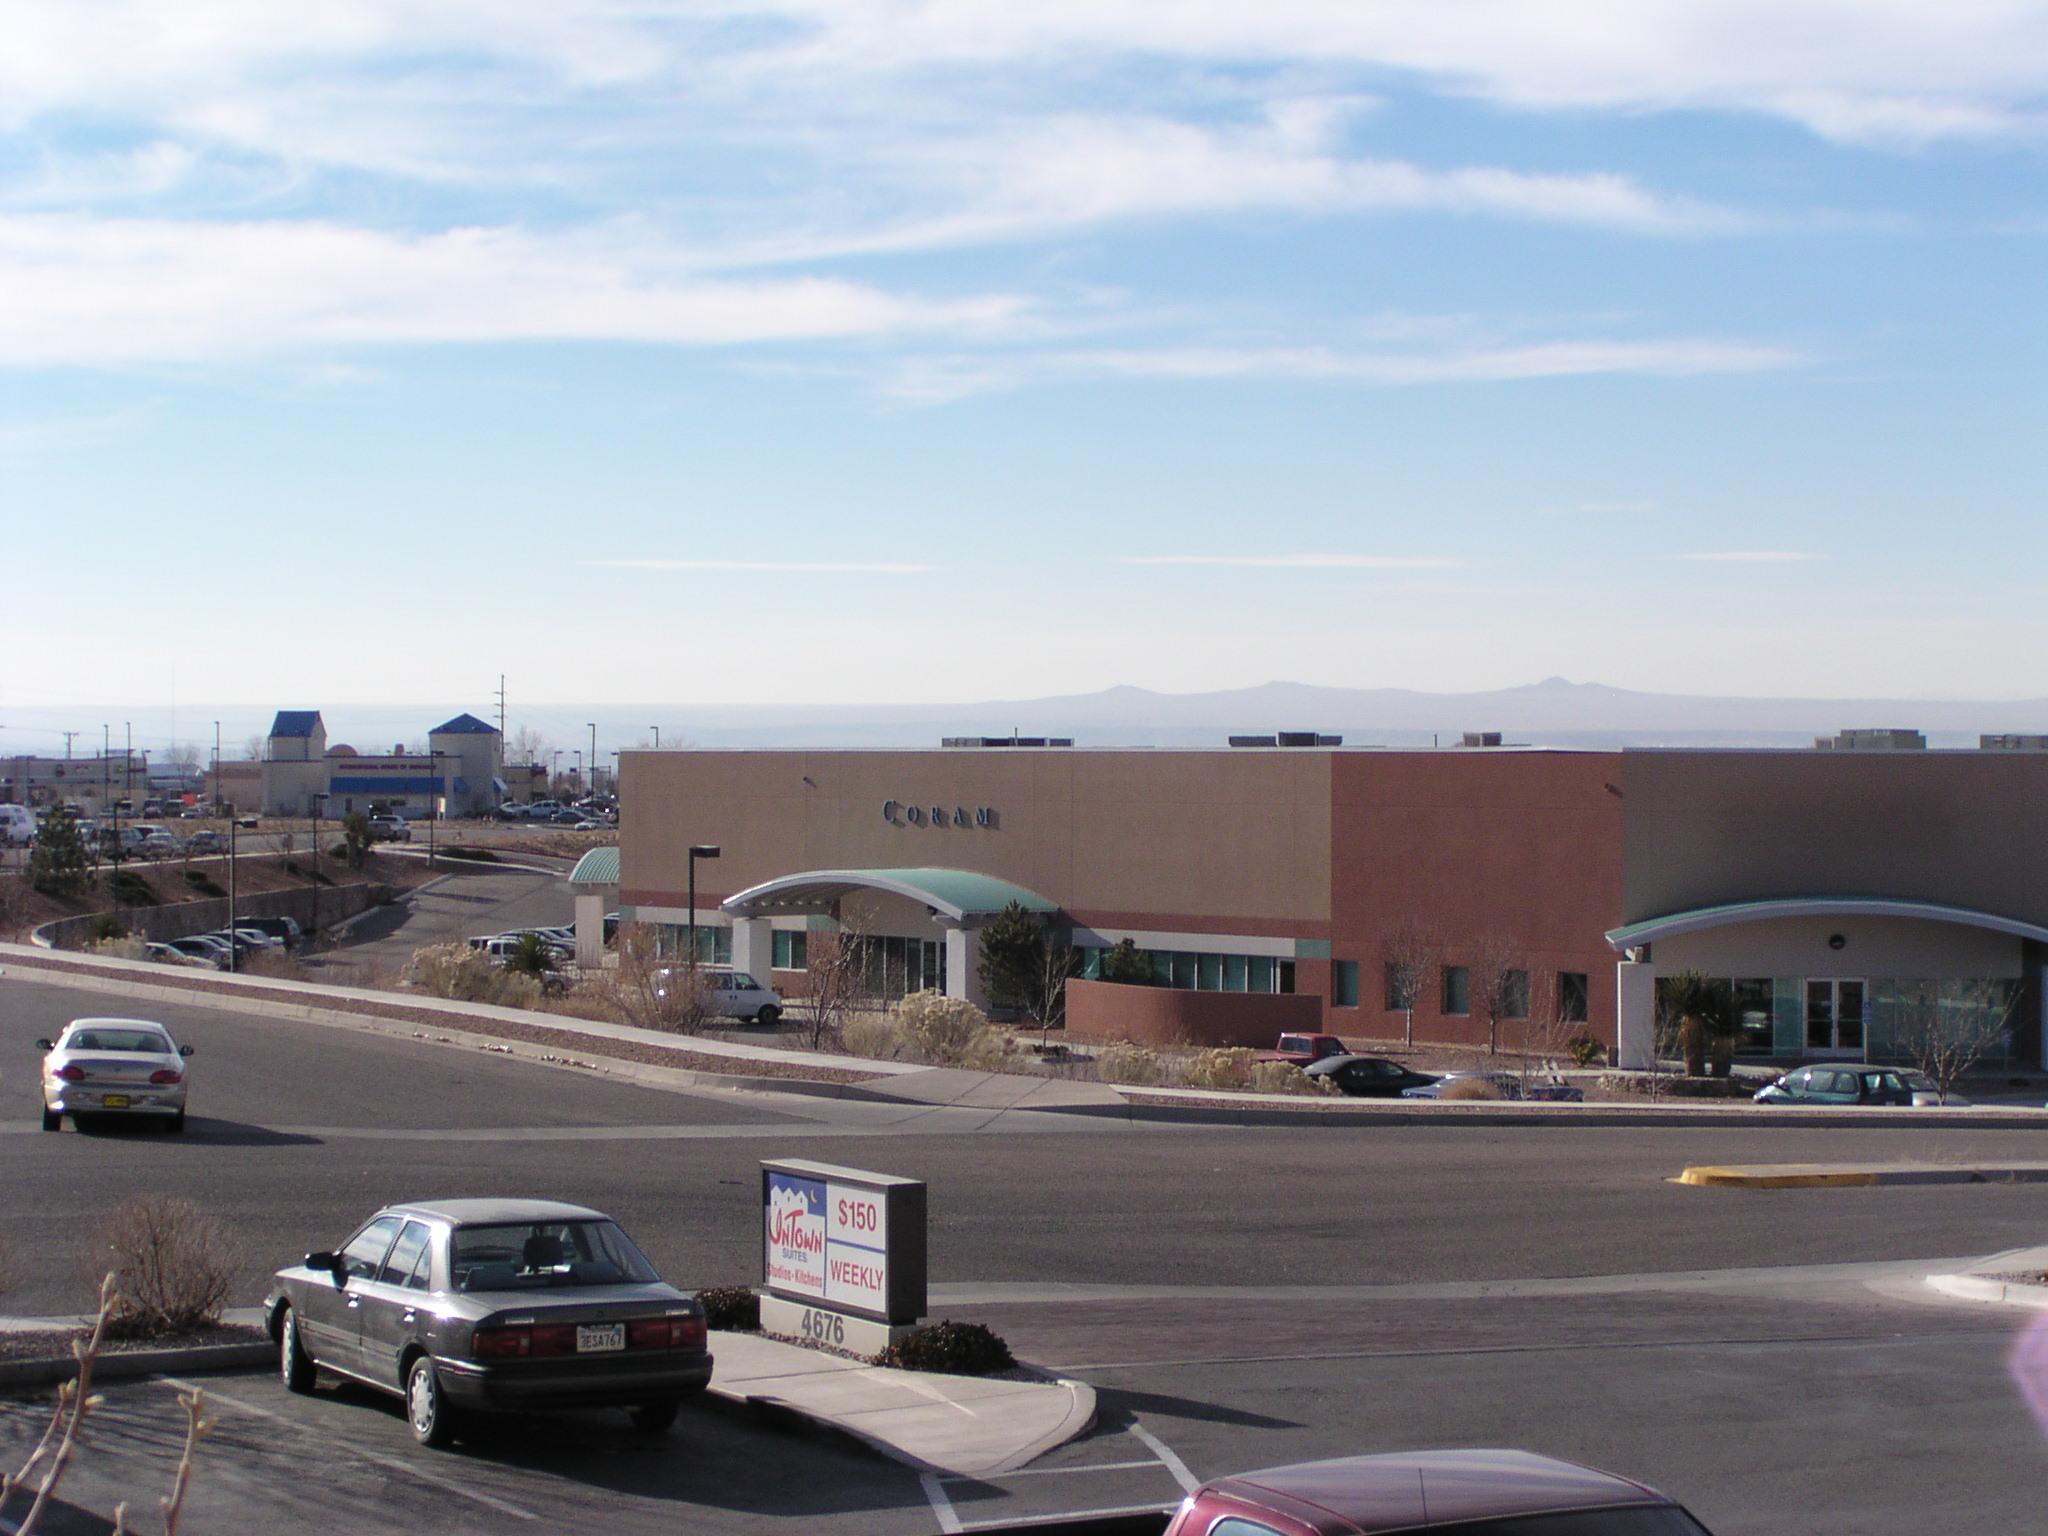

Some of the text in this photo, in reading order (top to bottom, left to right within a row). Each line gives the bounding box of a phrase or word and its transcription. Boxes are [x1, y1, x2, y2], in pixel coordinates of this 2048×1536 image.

[880, 799, 990, 825] CORAM
[838, 1197, 877, 1232] $150
[782, 1247, 808, 1263] SUITES
[830, 1259, 884, 1291] WEEKLY
[801, 1308, 845, 1344] 4676
